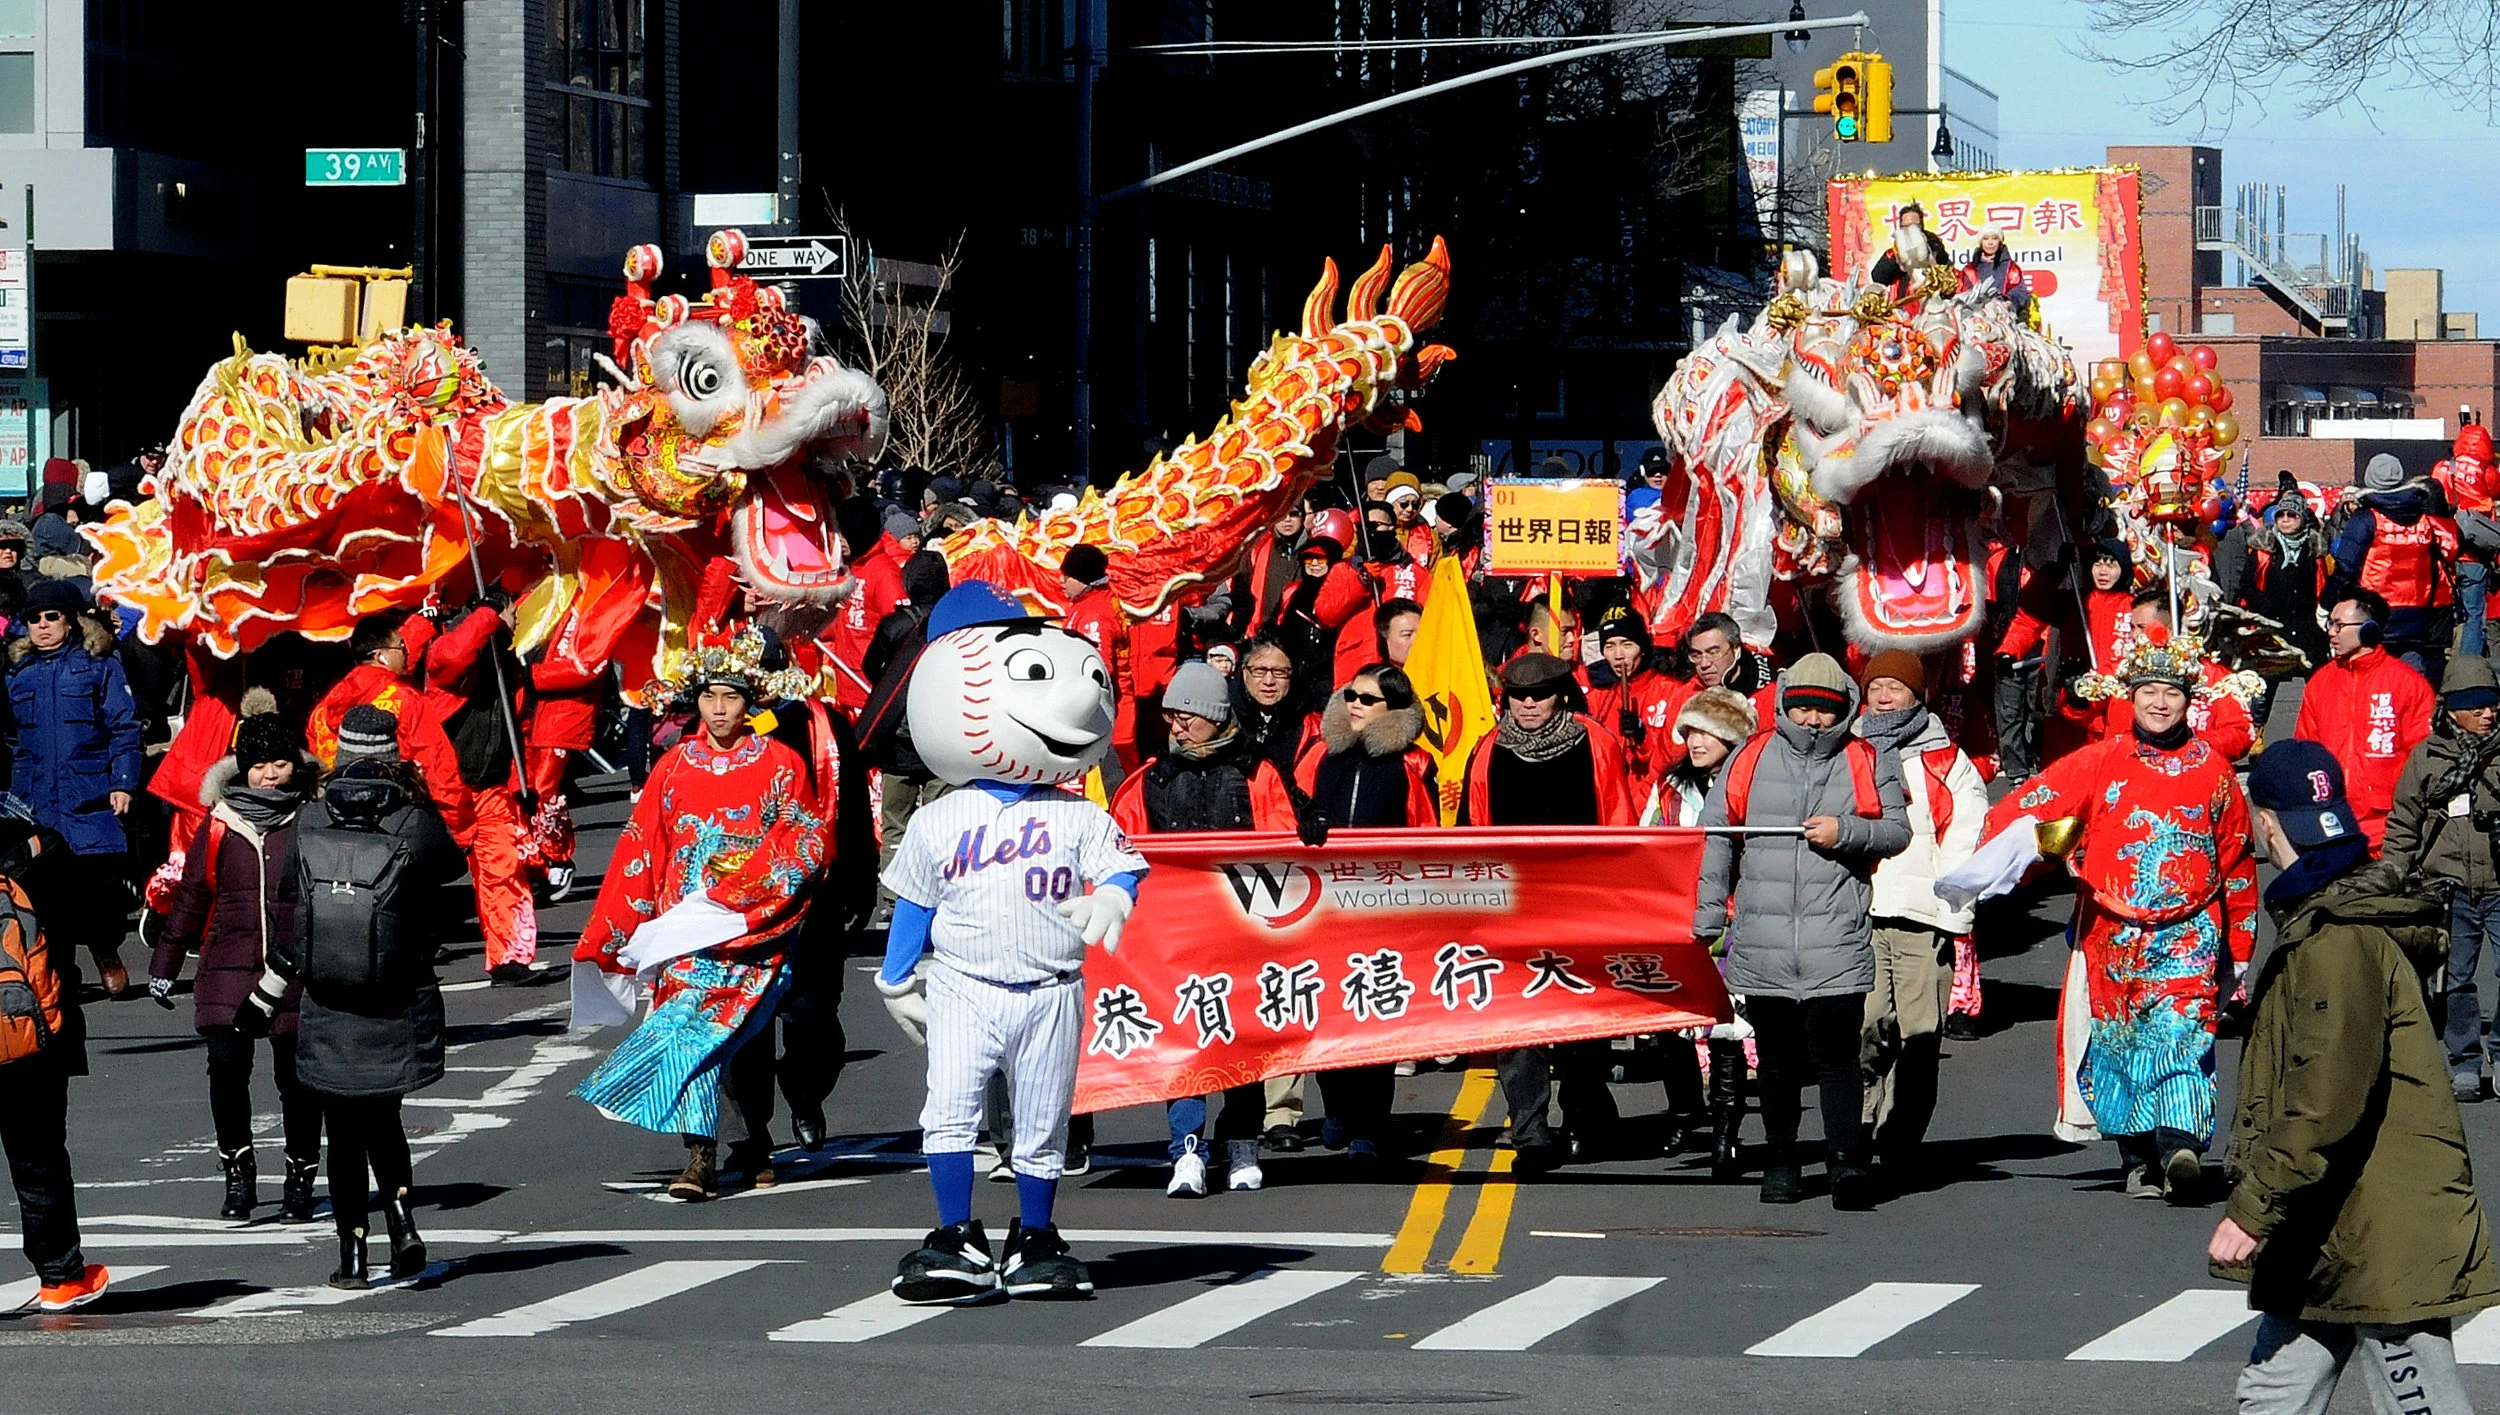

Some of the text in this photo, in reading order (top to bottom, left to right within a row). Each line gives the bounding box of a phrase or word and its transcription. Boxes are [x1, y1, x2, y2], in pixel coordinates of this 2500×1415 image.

[325, 153, 361, 180] 39
[1885, 200, 2083, 242] 界日報
[746, 250, 827, 266] ONE WAY
[1496, 490, 1516, 505] 01
[1498, 517, 1612, 545] 世界日報
[2308, 770, 2332, 802] B
[943, 816, 1052, 881] Mets
[1025, 866, 1072, 902] 00
[1324, 861, 1511, 885] 世界日報
[1334, 888, 1509, 909] World Journal
[1088, 943, 1682, 1058] 恭賀新禧行大運
[2380, 1340, 2433, 1415] IST
